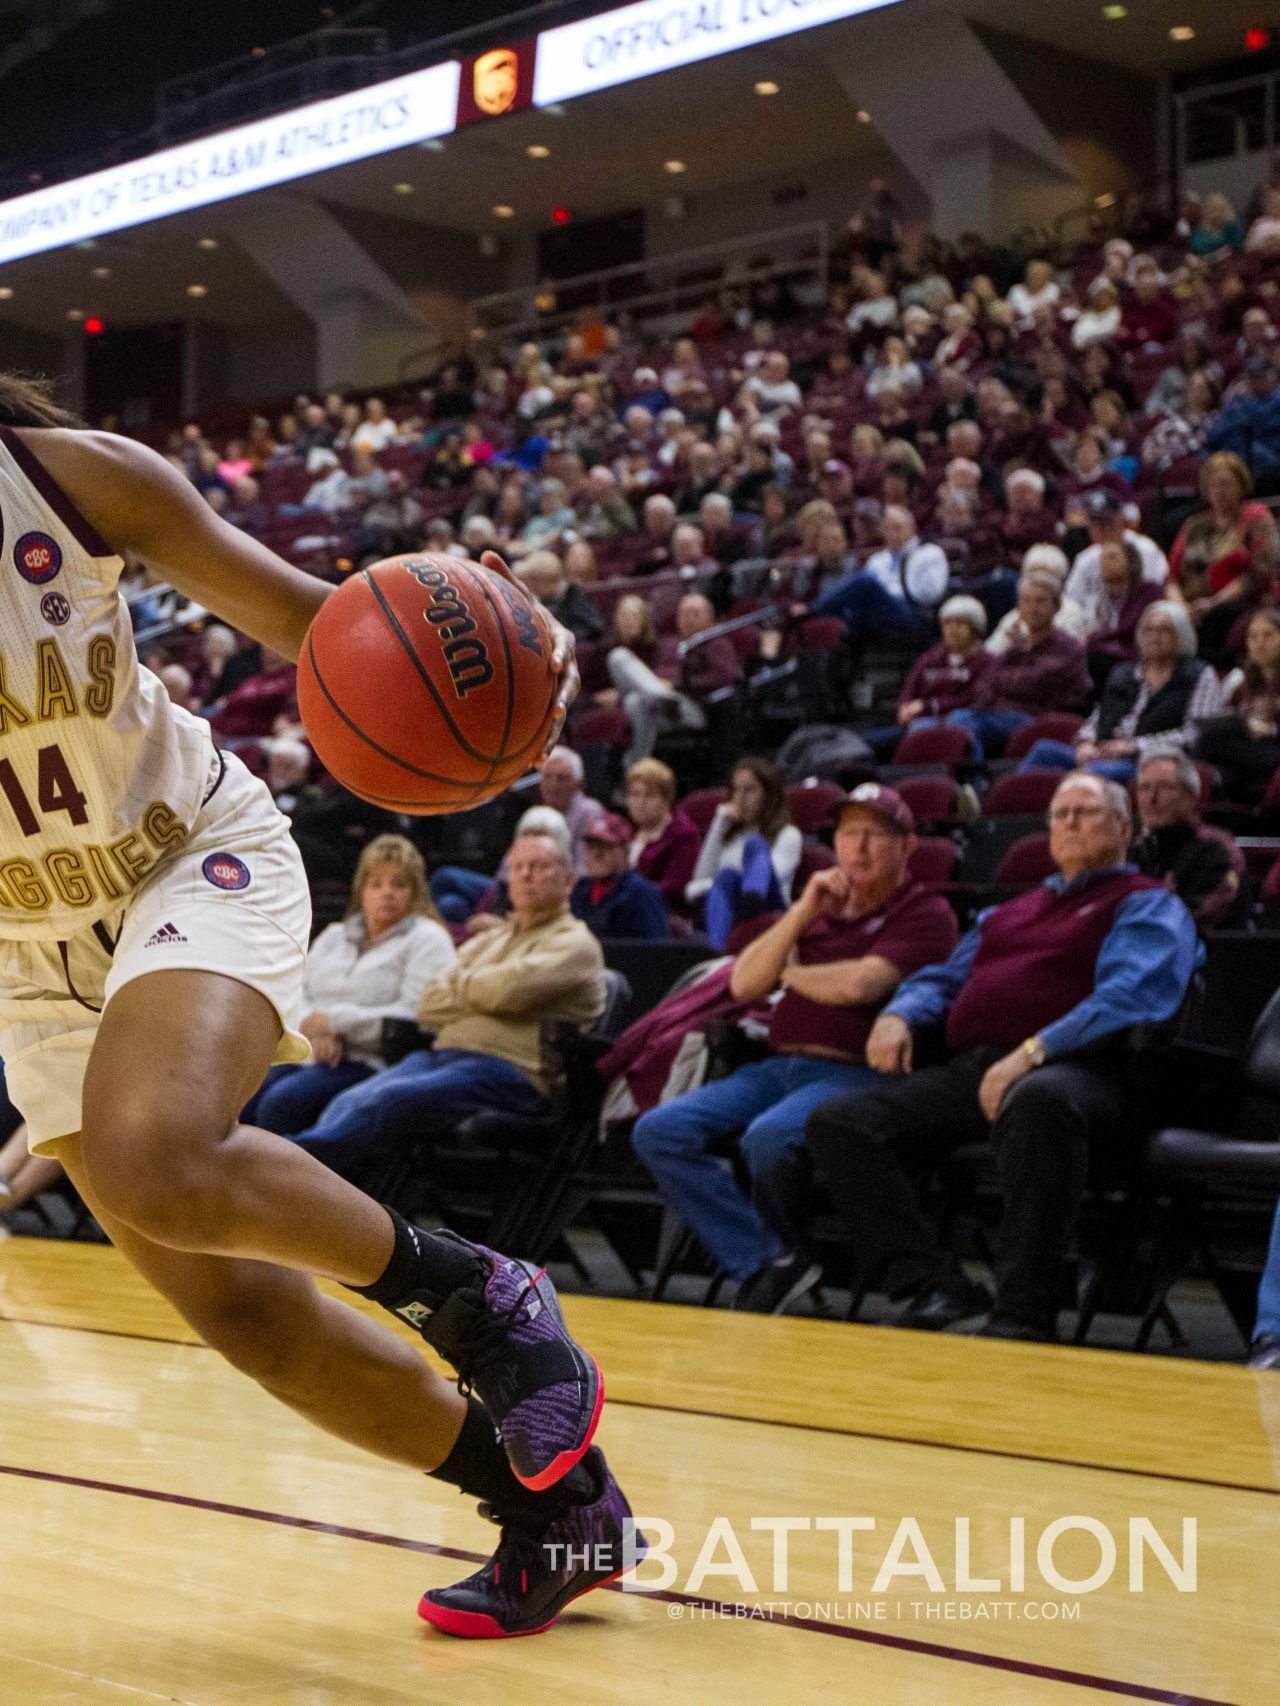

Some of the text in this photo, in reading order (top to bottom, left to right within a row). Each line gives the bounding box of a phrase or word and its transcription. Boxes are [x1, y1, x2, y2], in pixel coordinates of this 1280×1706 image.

[582, 0, 725, 69] OFFICIAL
[89, 181, 123, 217] OF
[129, 158, 200, 206] TEXAS
[208, 139, 268, 181] A&M
[273, 94, 411, 163] ATHLETICS
[23, 548, 50, 568] CBC
[42, 593, 69, 623] SEC
[400, 556, 494, 700] Wilson
